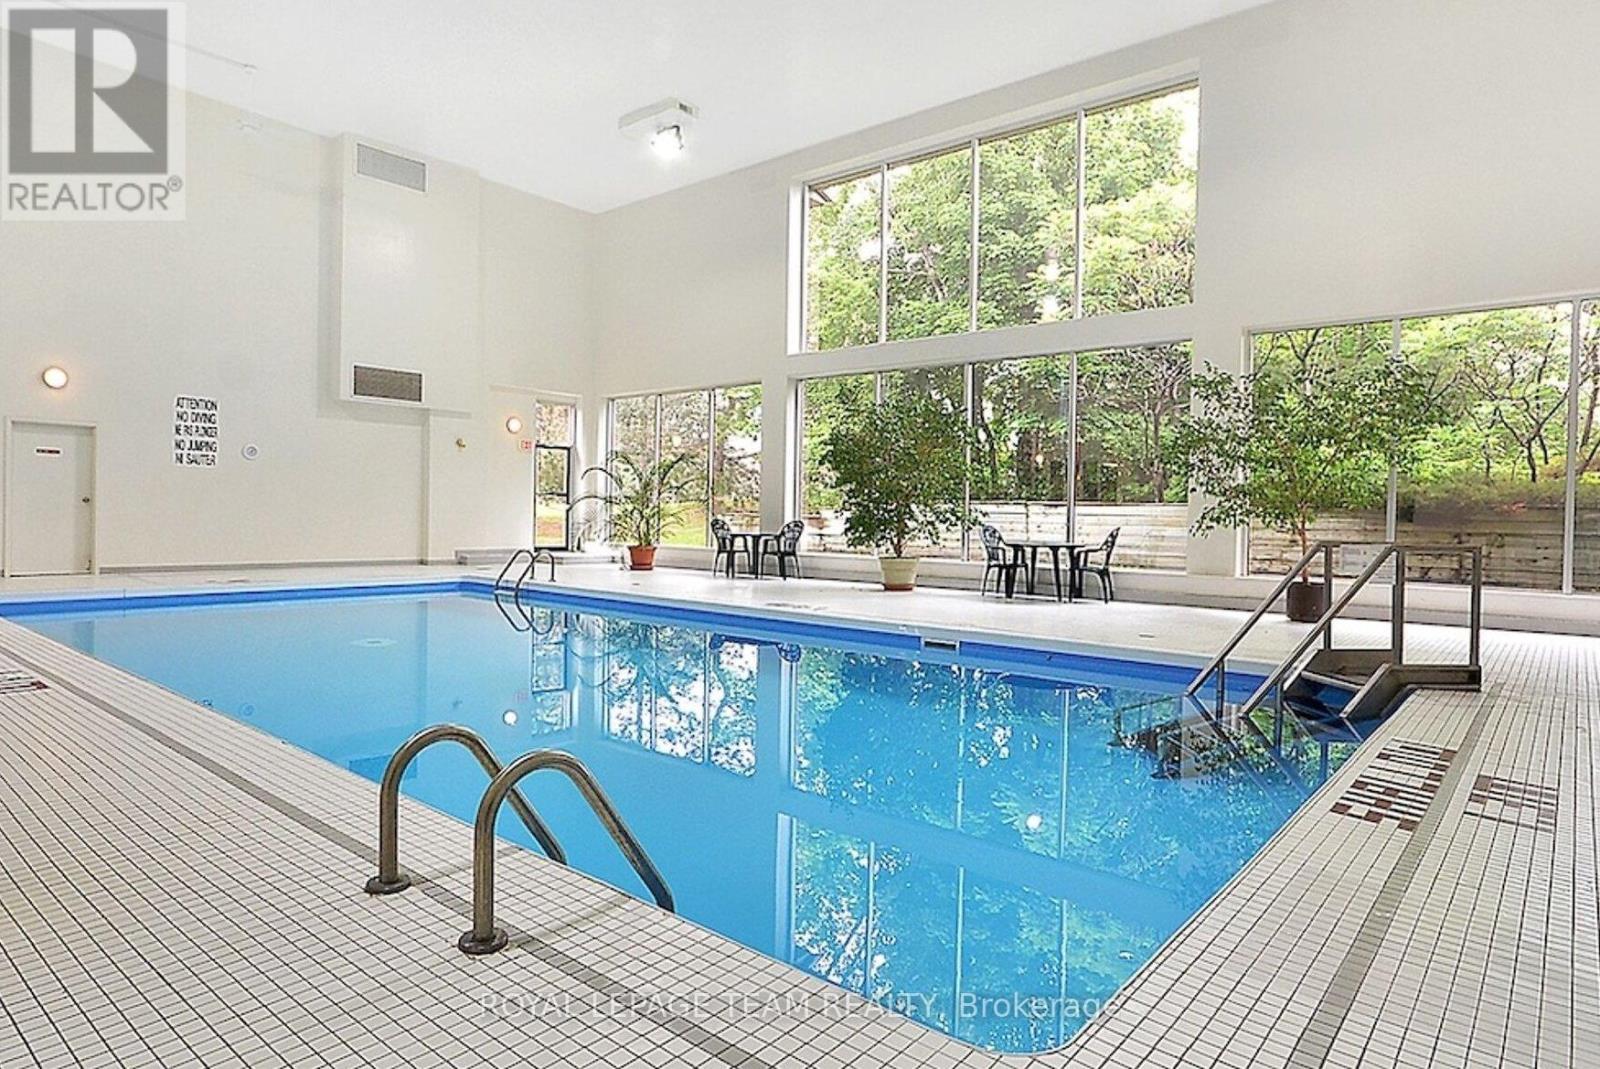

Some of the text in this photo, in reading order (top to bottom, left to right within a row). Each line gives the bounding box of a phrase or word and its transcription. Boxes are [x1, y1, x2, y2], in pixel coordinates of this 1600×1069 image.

[176, 396, 218, 411] ATTENTION
[176, 411, 217, 425] NO DIVING
[175, 439, 217, 453] NO JUMPING
